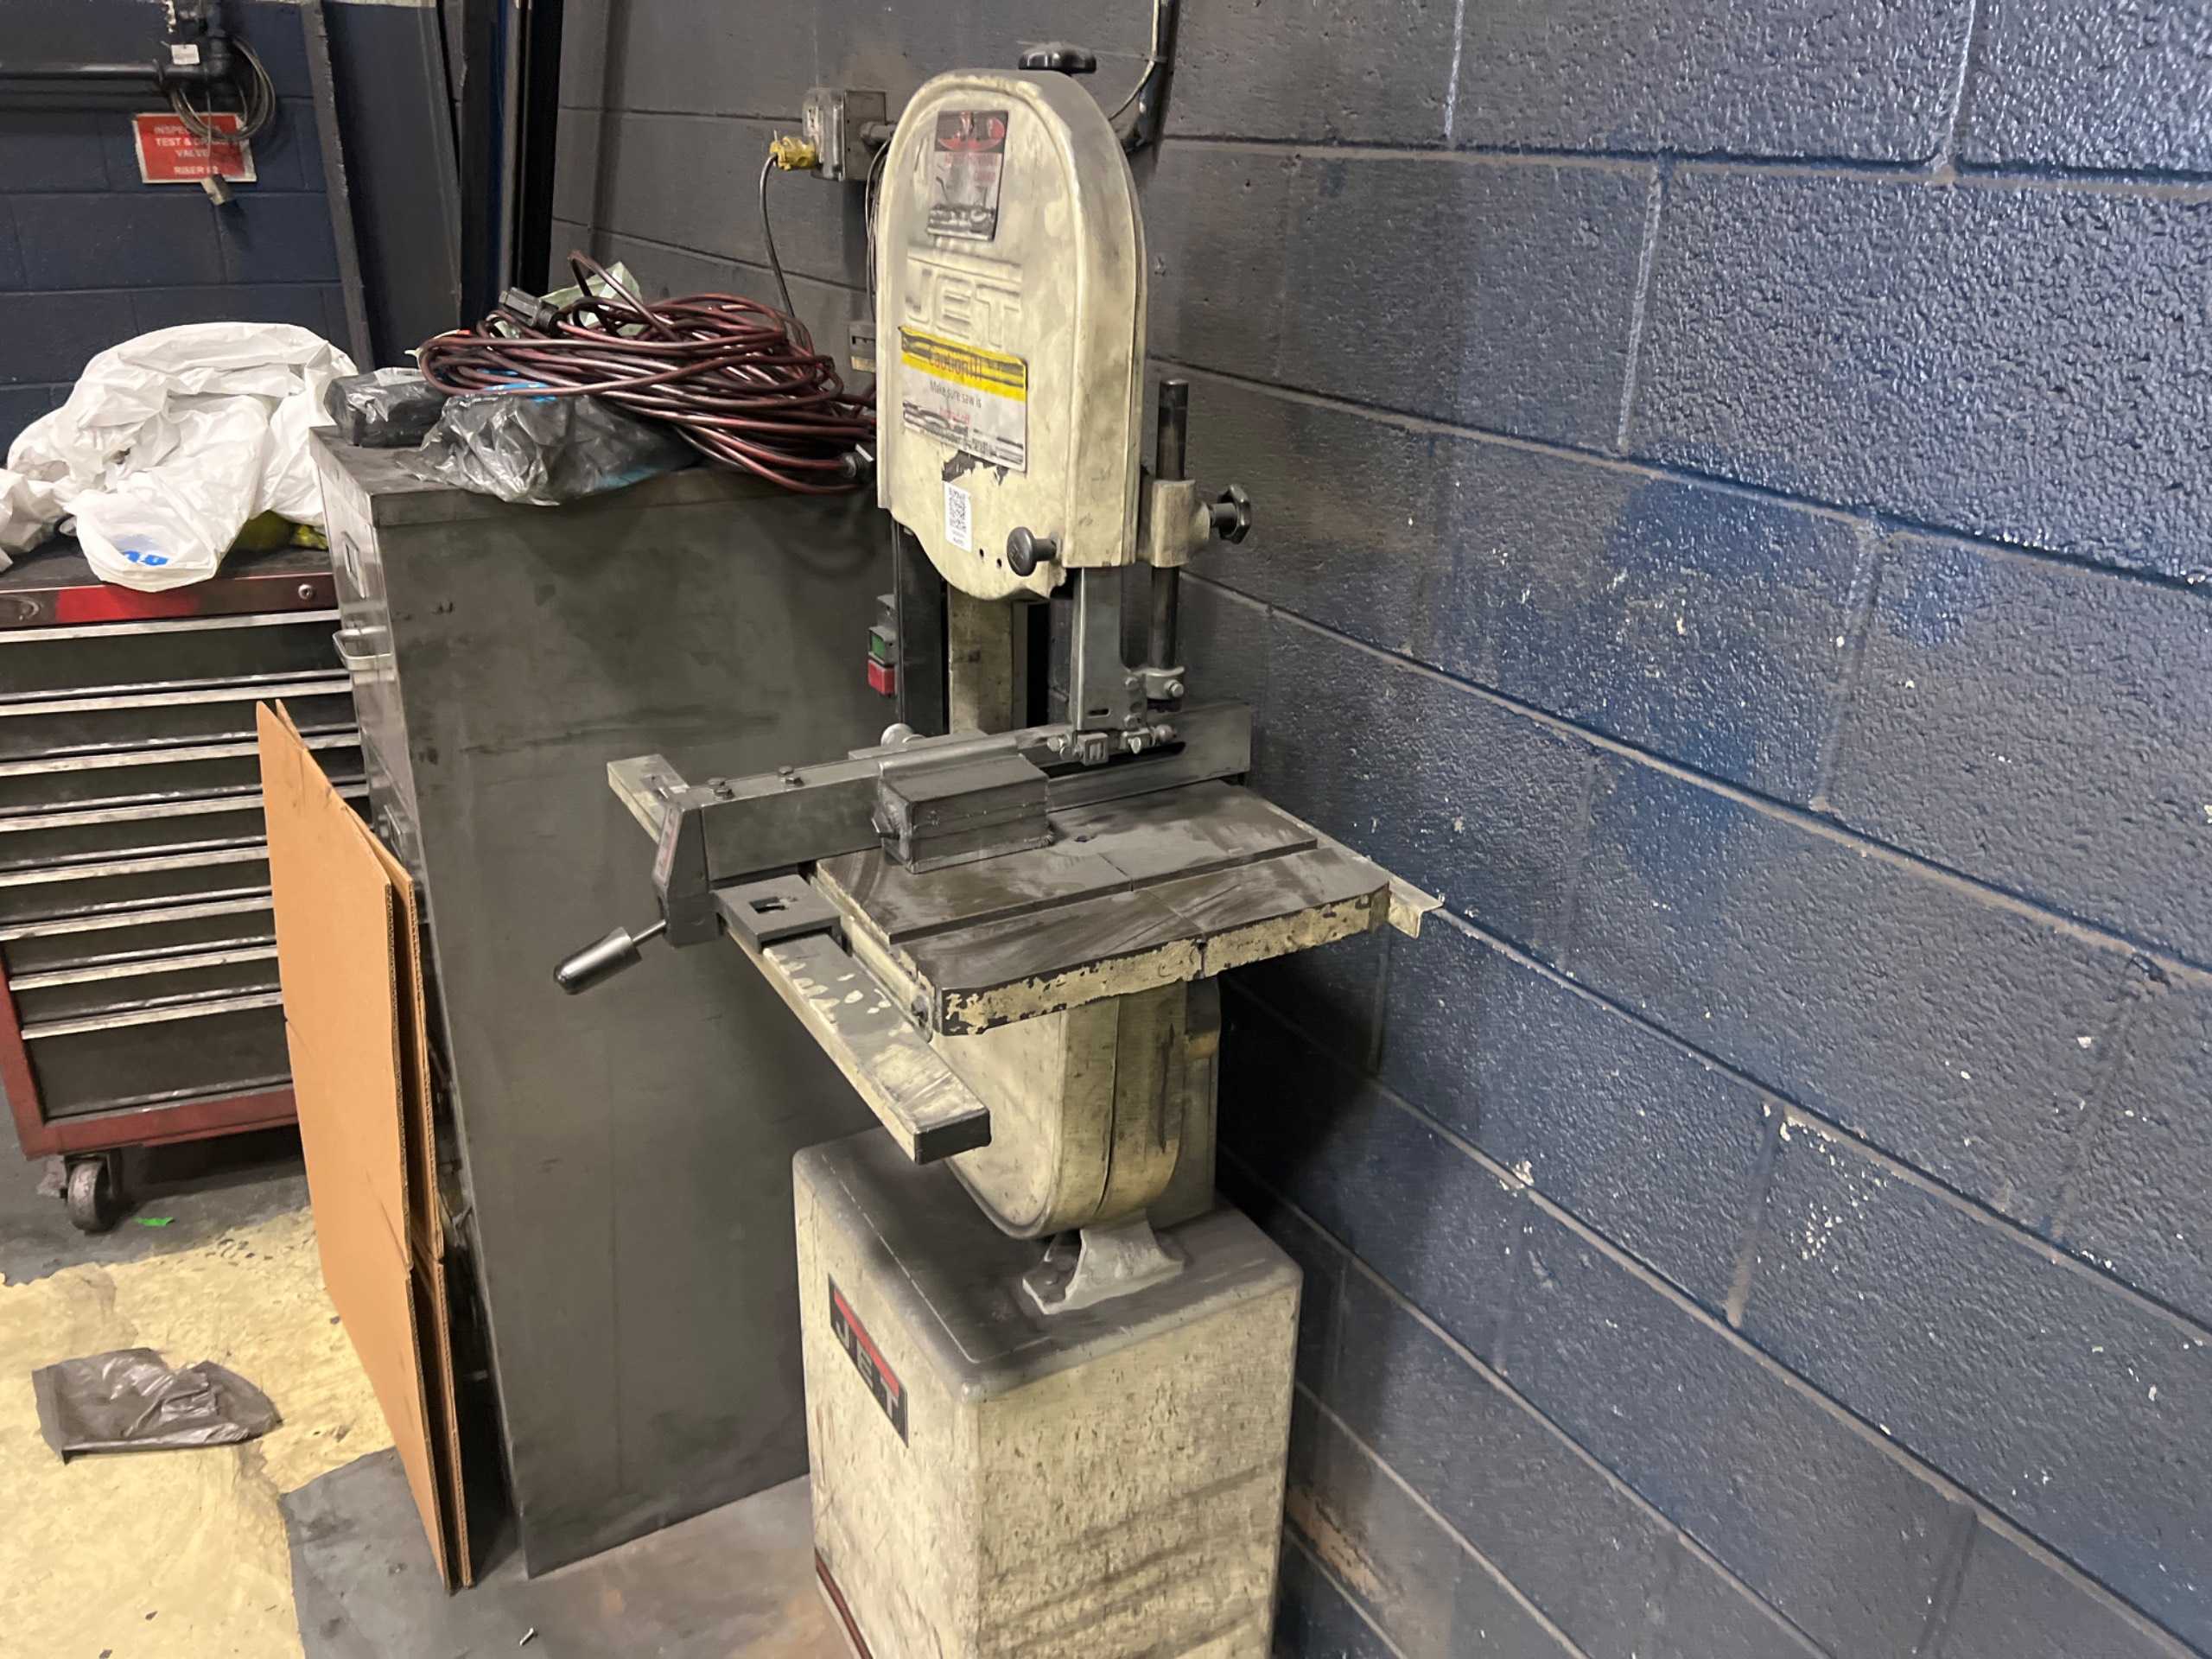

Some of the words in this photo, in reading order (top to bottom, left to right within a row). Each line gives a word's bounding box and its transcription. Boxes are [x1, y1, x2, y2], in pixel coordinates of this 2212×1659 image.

[156, 137, 181, 146] TEST
[906, 267, 1022, 350] JET
[835, 1319, 899, 1421] JET
